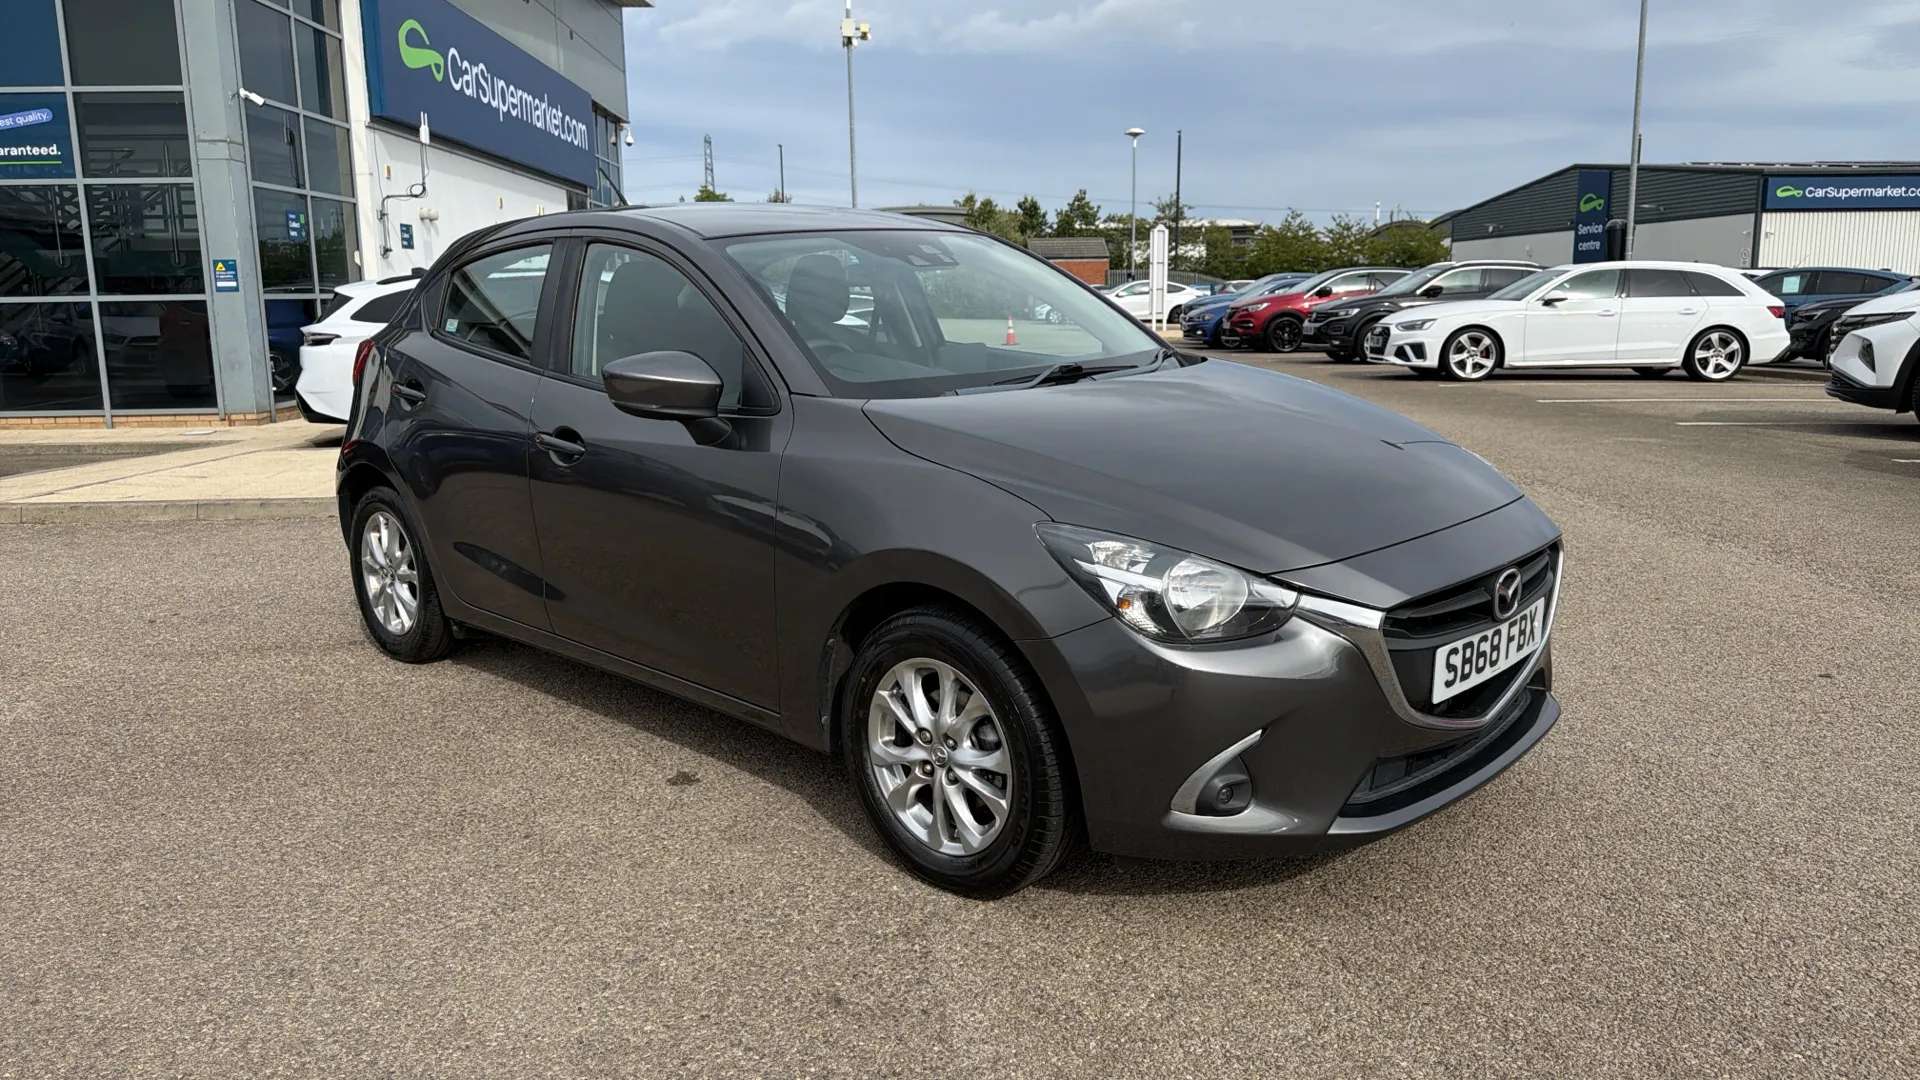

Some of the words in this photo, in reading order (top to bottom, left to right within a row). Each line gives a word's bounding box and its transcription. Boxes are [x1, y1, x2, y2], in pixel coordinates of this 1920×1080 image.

[448, 47, 589, 150] CarSupermarket.com
[16, 112, 50, 126] quality.
[1578, 222, 1603, 235] Service
[1578, 240, 1601, 251] centre
[1444, 628, 1502, 689] SB68
[1505, 606, 1538, 660] FBX
